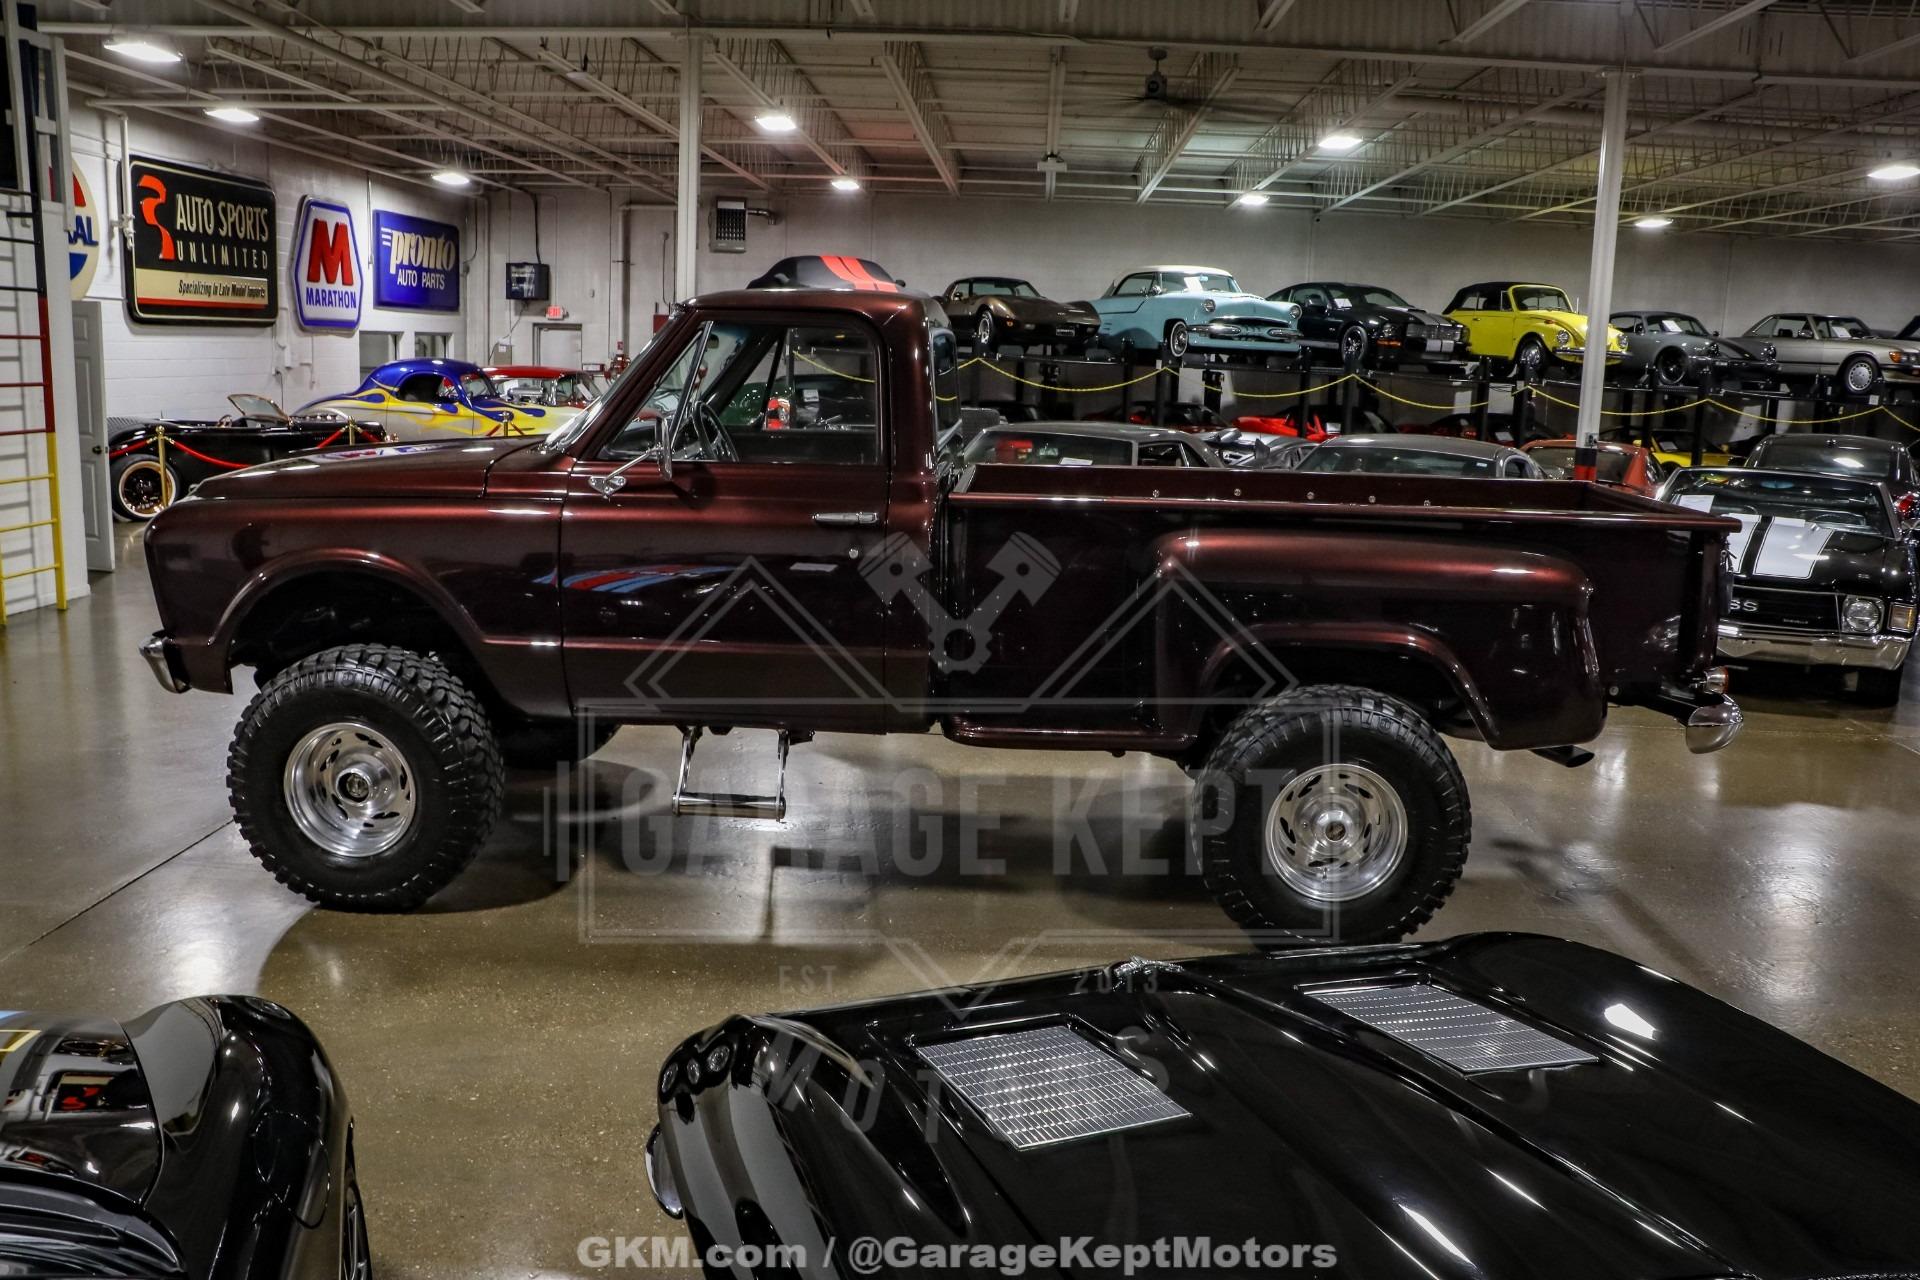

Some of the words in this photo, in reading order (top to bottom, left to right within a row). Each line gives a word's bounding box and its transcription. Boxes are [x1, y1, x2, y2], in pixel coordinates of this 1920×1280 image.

[176, 193, 215, 235] AUTO
[217, 201, 269, 242] SPORTS
[176, 240, 268, 270] UNLIMITED
[306, 218, 354, 286] M
[389, 229, 456, 275] pronto
[178, 280, 212, 298] Specializing
[219, 283, 231, 297] Late
[397, 269, 418, 286] AUTO
[421, 271, 446, 290] PARTS
[305, 286, 357, 309] MARATHON
